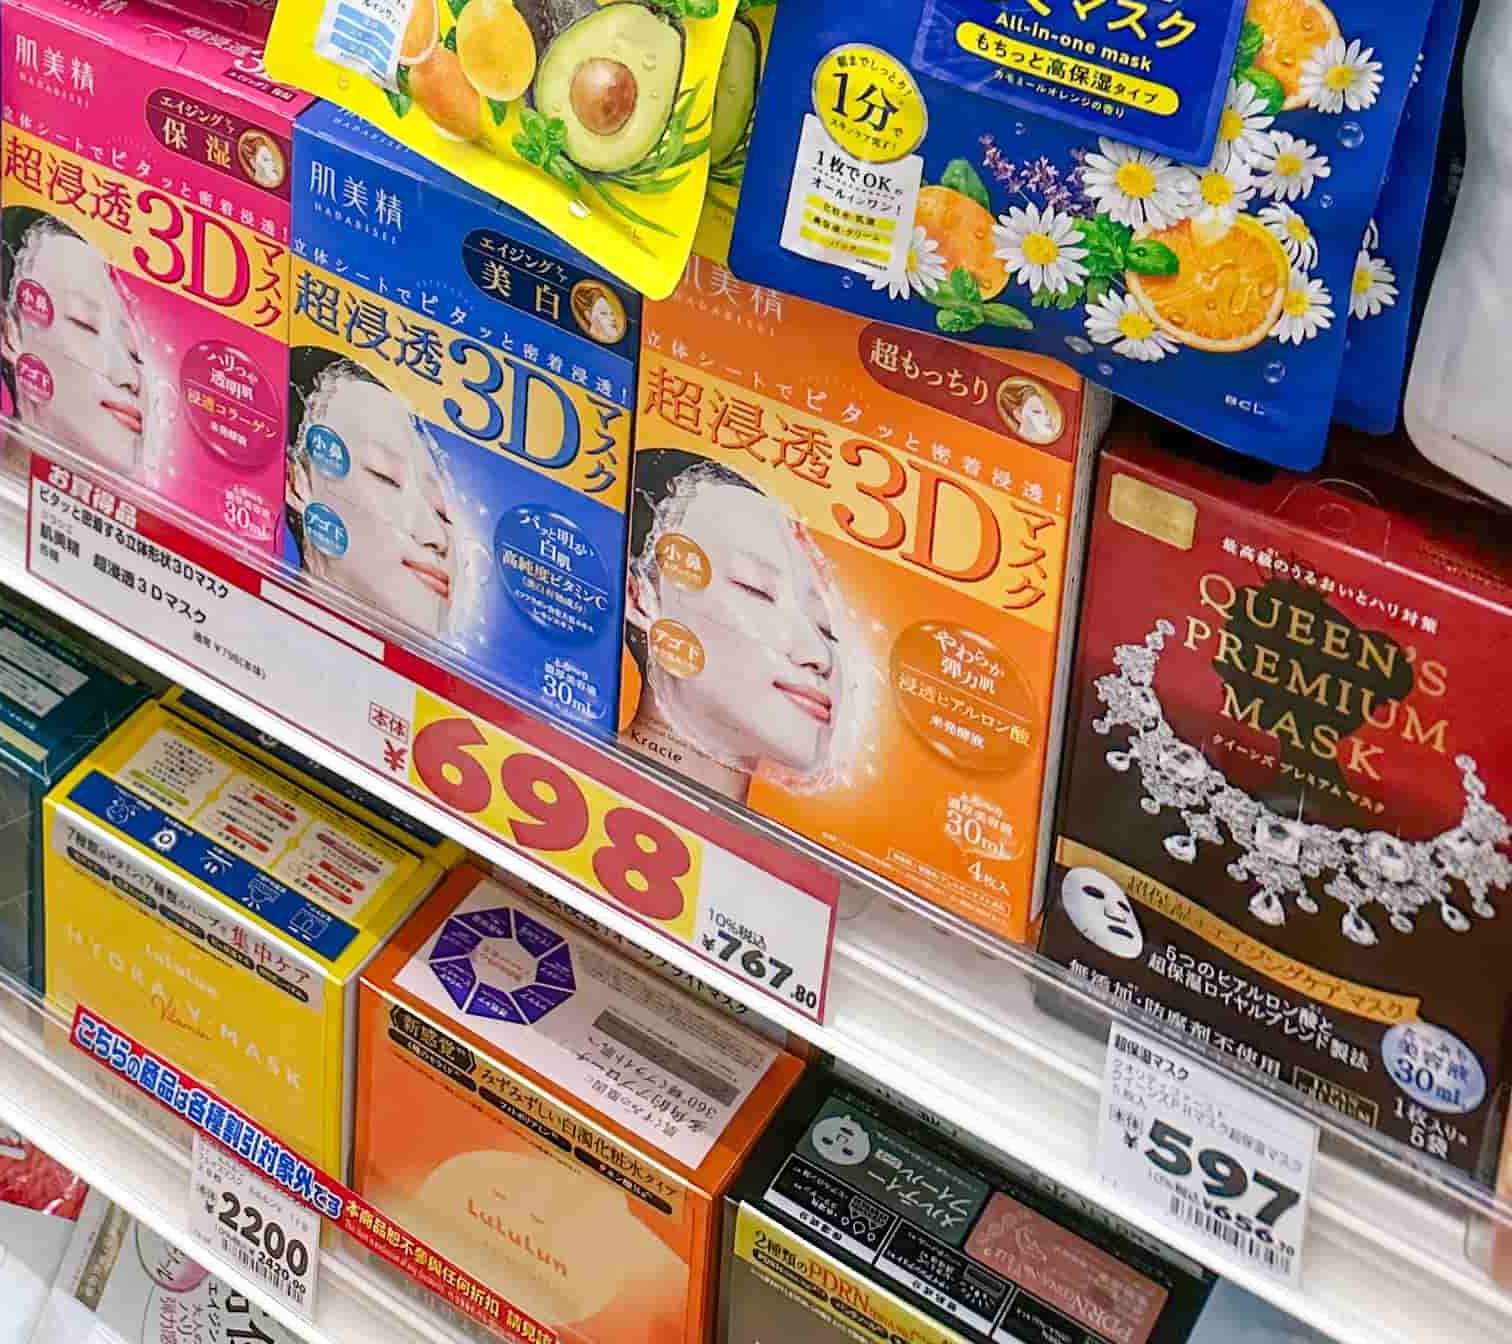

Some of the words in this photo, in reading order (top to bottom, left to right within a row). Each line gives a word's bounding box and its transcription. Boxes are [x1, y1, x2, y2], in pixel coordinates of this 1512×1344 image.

[1100, 41, 1154, 73] mask
[309, 160, 403, 232] 肌美精
[870, 337, 991, 408] 超もっちり
[1183, 615, 1449, 753] PREMIUM
[1199, 572, 1449, 699] QUEEN'S
[1220, 684, 1386, 783] MASK
[412, 717, 693, 922] 698
[77, 1015, 345, 1218] こちらの商品は各種割引対象外です
[1144, 1120, 1301, 1226] 597
